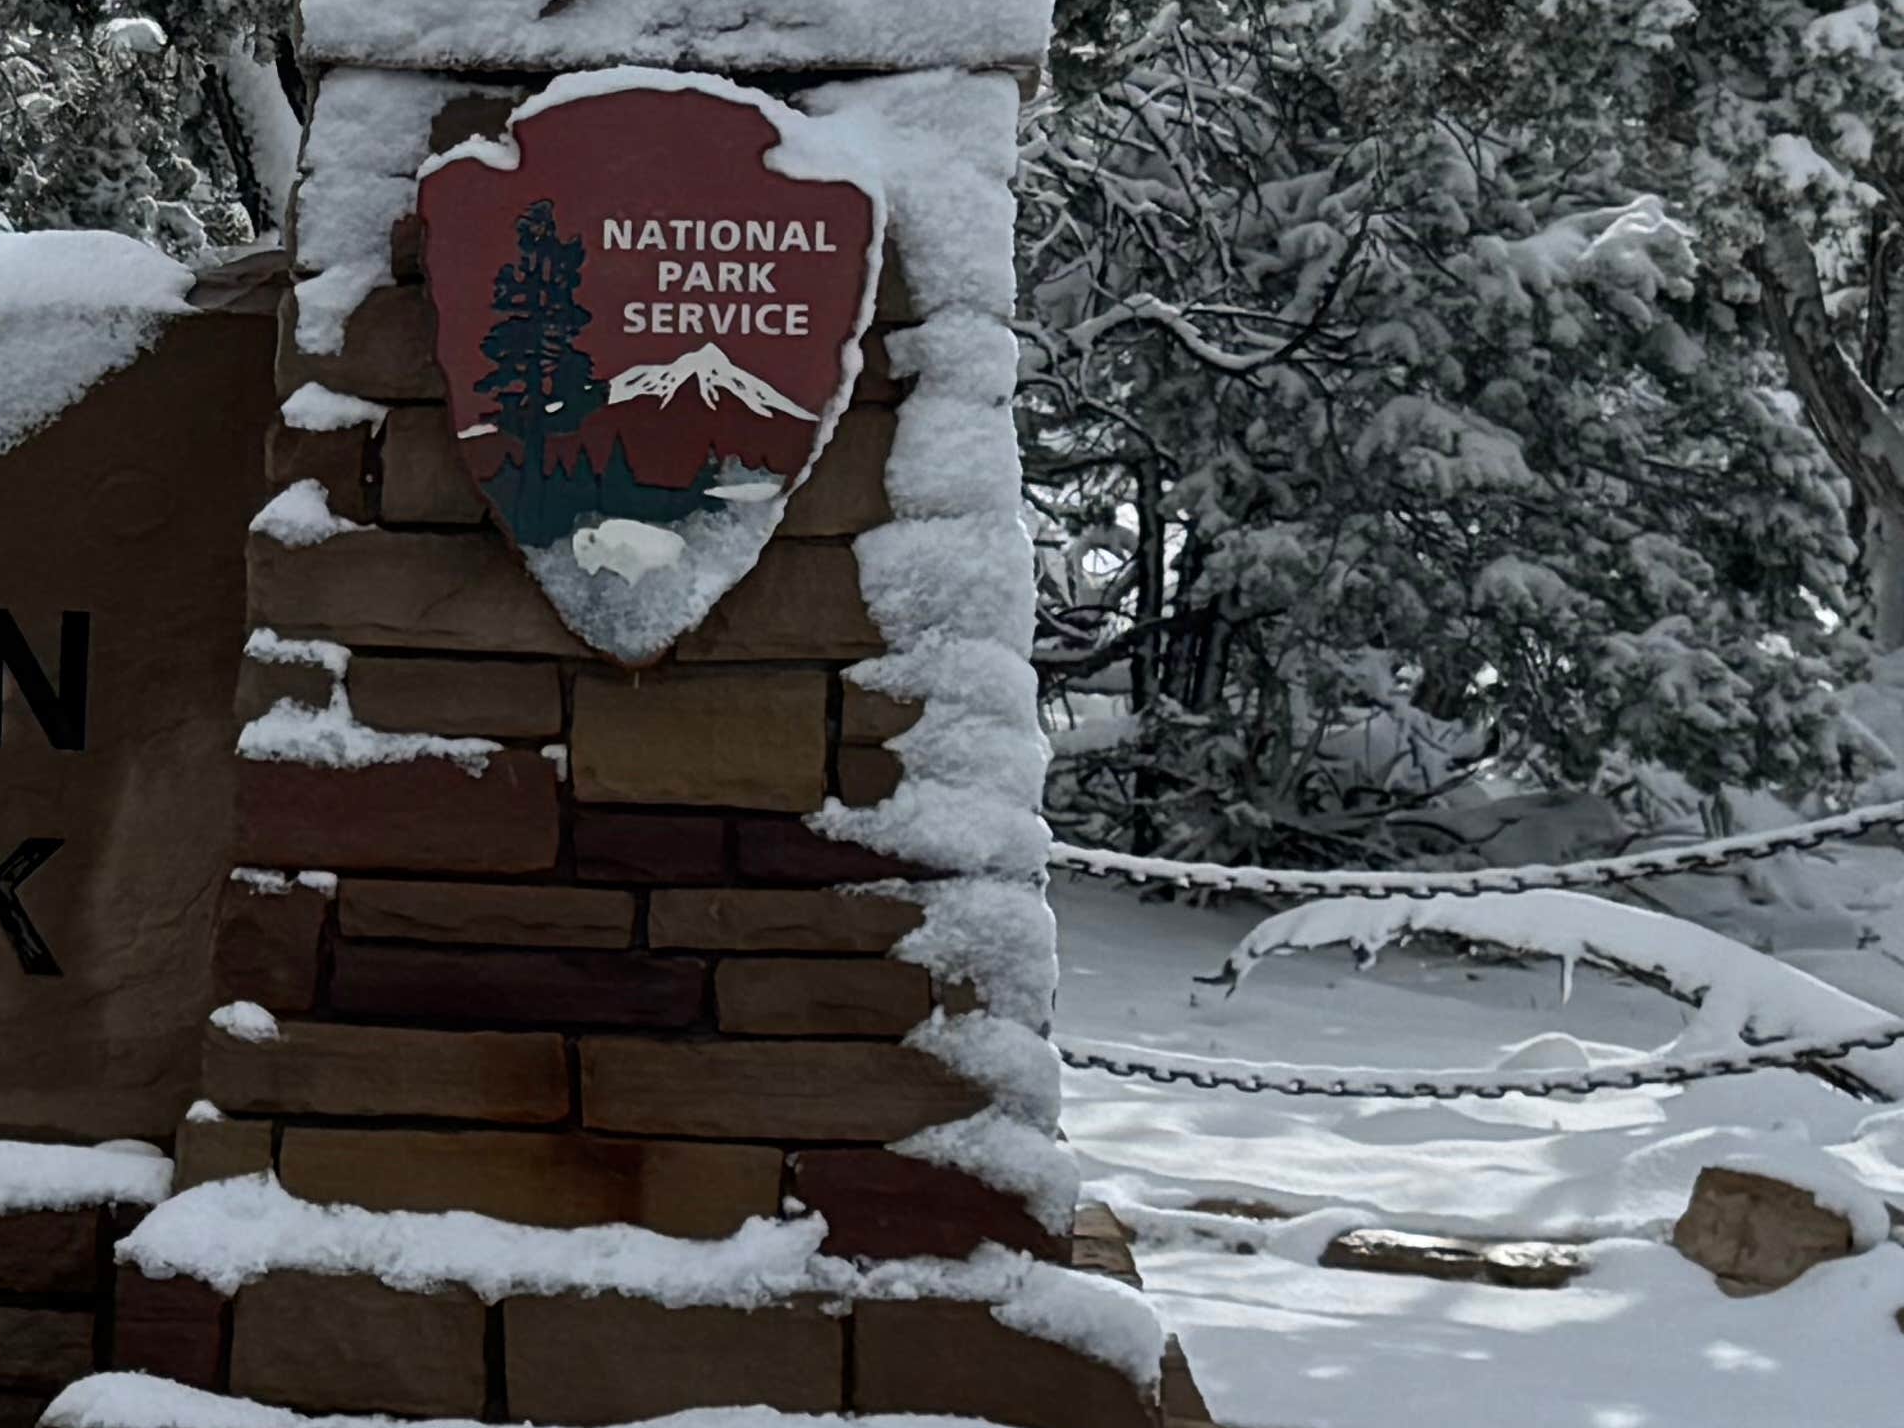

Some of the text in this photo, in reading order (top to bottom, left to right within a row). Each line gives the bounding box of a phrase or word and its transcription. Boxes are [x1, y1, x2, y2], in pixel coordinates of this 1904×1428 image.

[602, 219, 837, 252] NATIONAL
[657, 262, 776, 293] PARK
[622, 302, 810, 336] SERVICE
